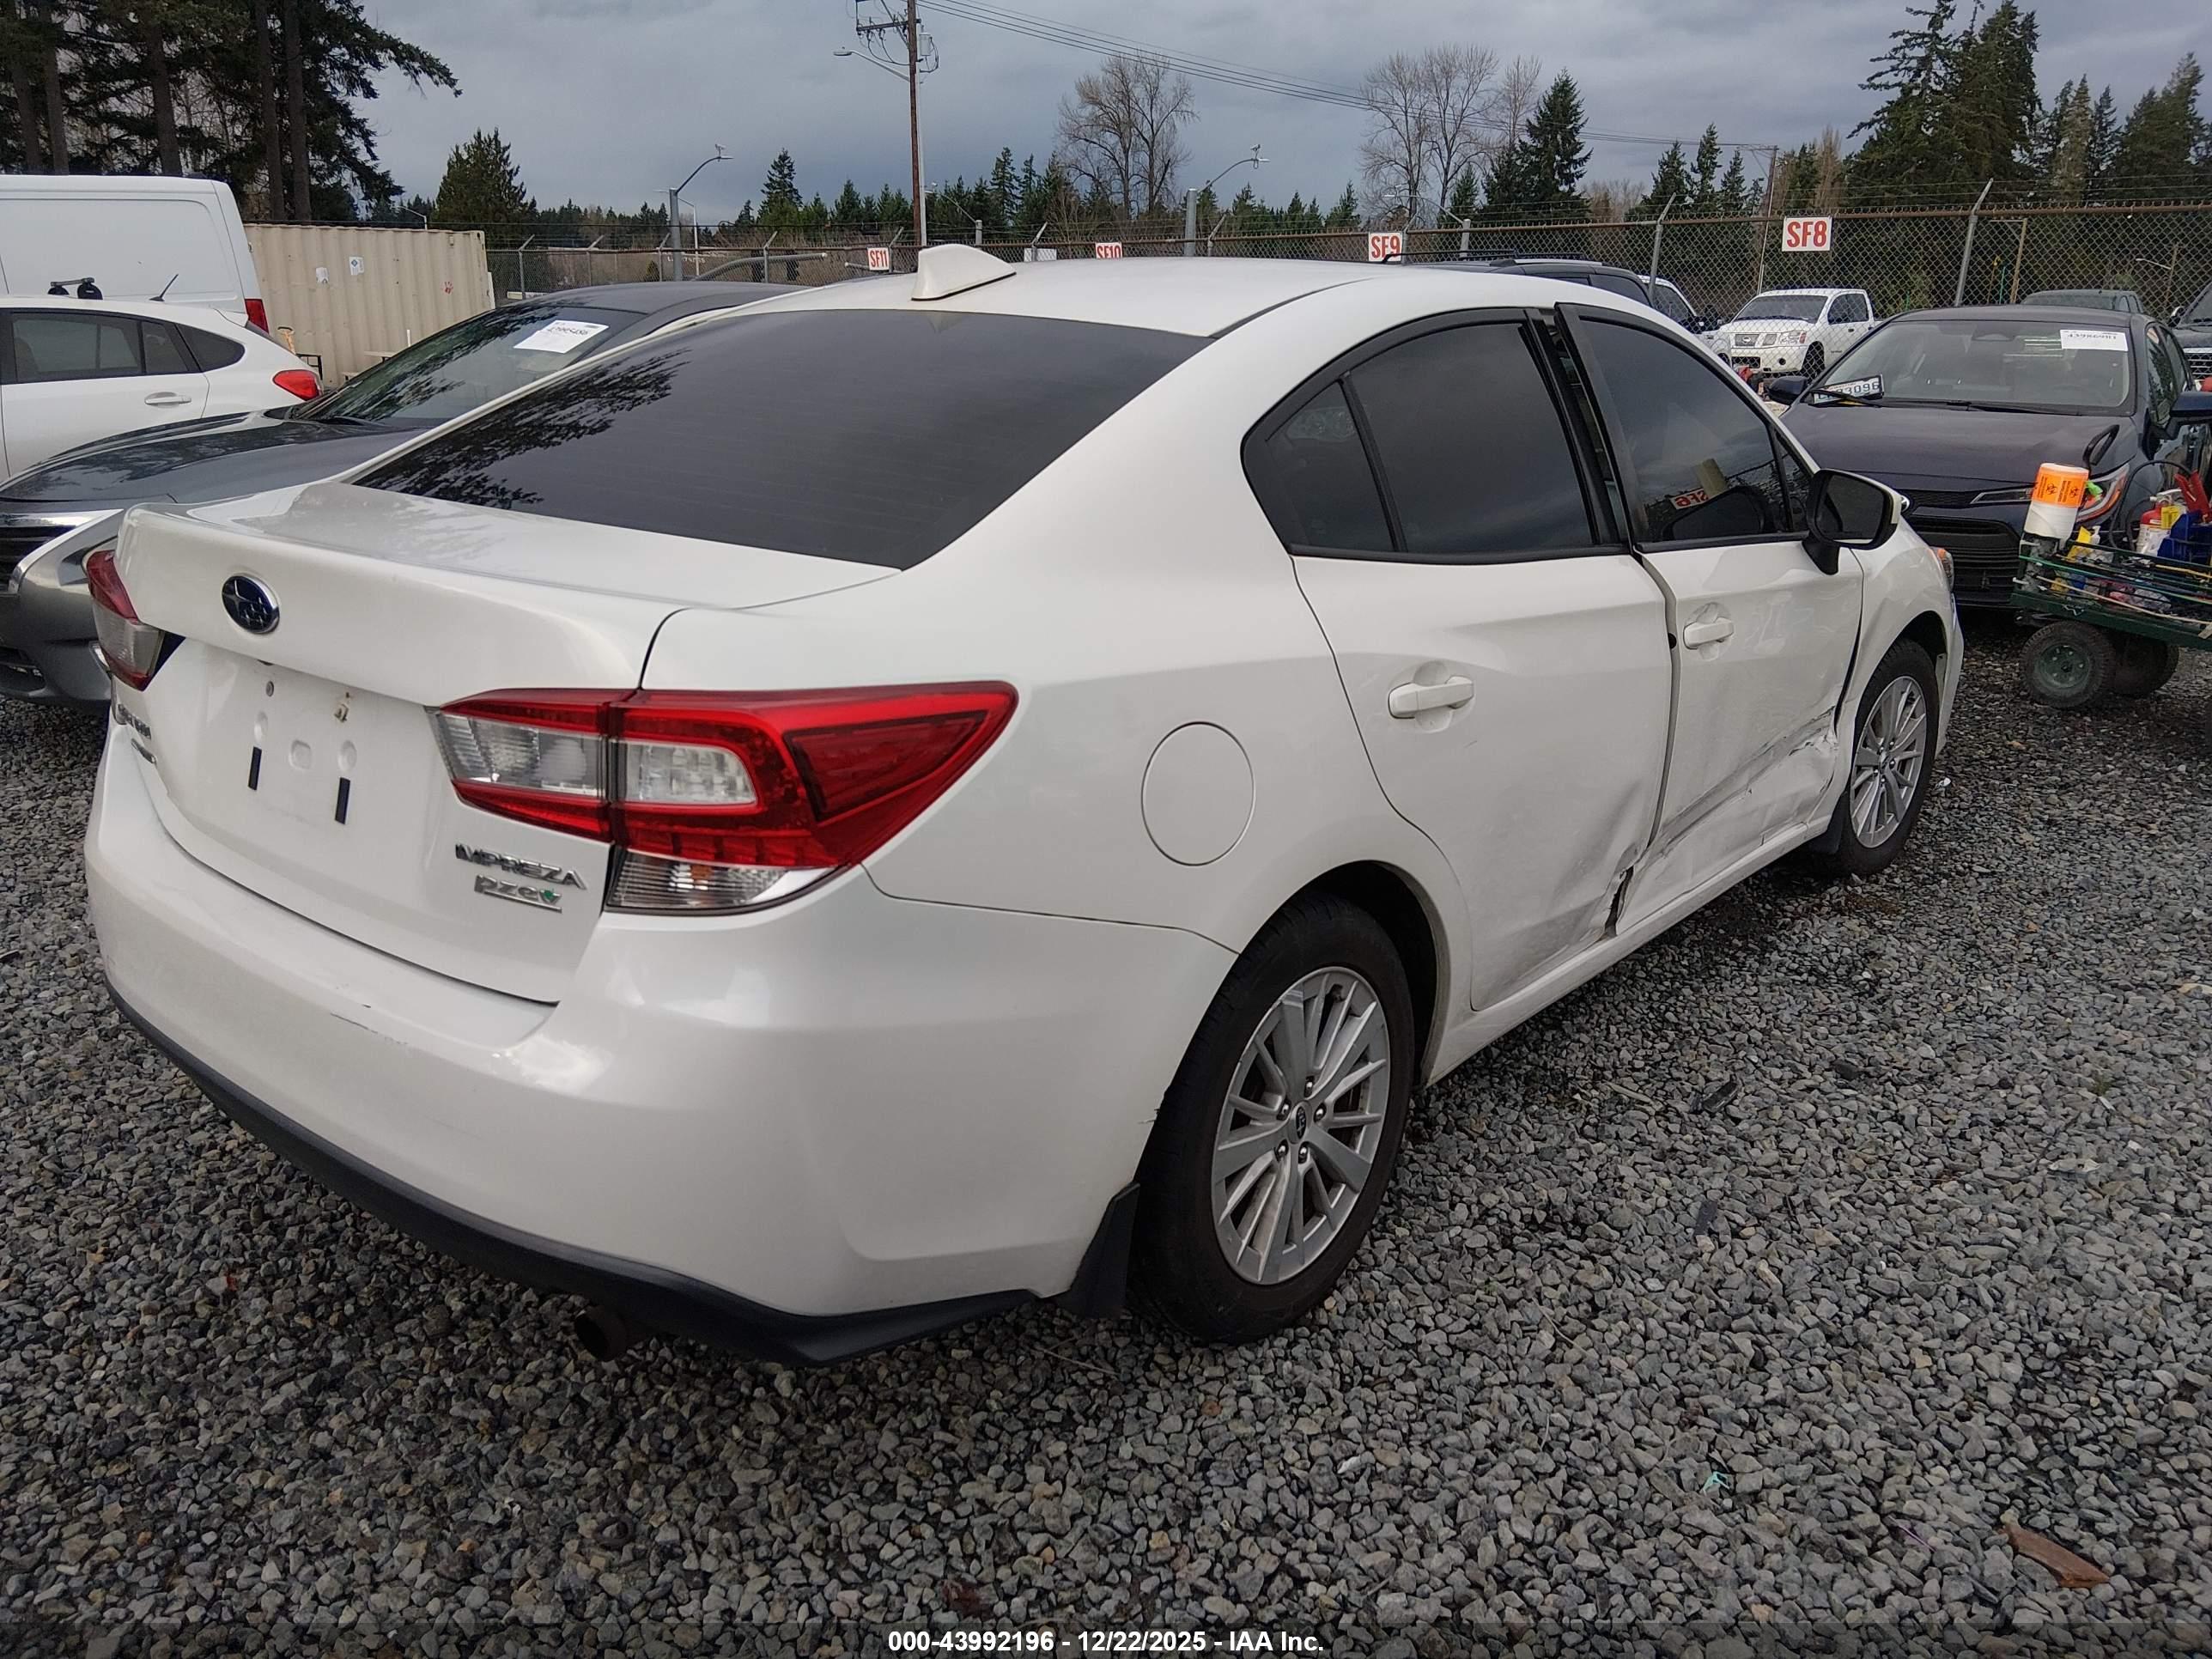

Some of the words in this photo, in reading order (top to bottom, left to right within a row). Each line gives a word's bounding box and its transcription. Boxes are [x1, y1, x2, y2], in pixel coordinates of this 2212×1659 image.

[1787, 221, 1828, 248] SF8
[1097, 245, 1121, 258] SF10
[1371, 235, 1401, 258] SF9
[870, 250, 888, 268] SF11
[455, 842, 587, 890] IMPREZA
